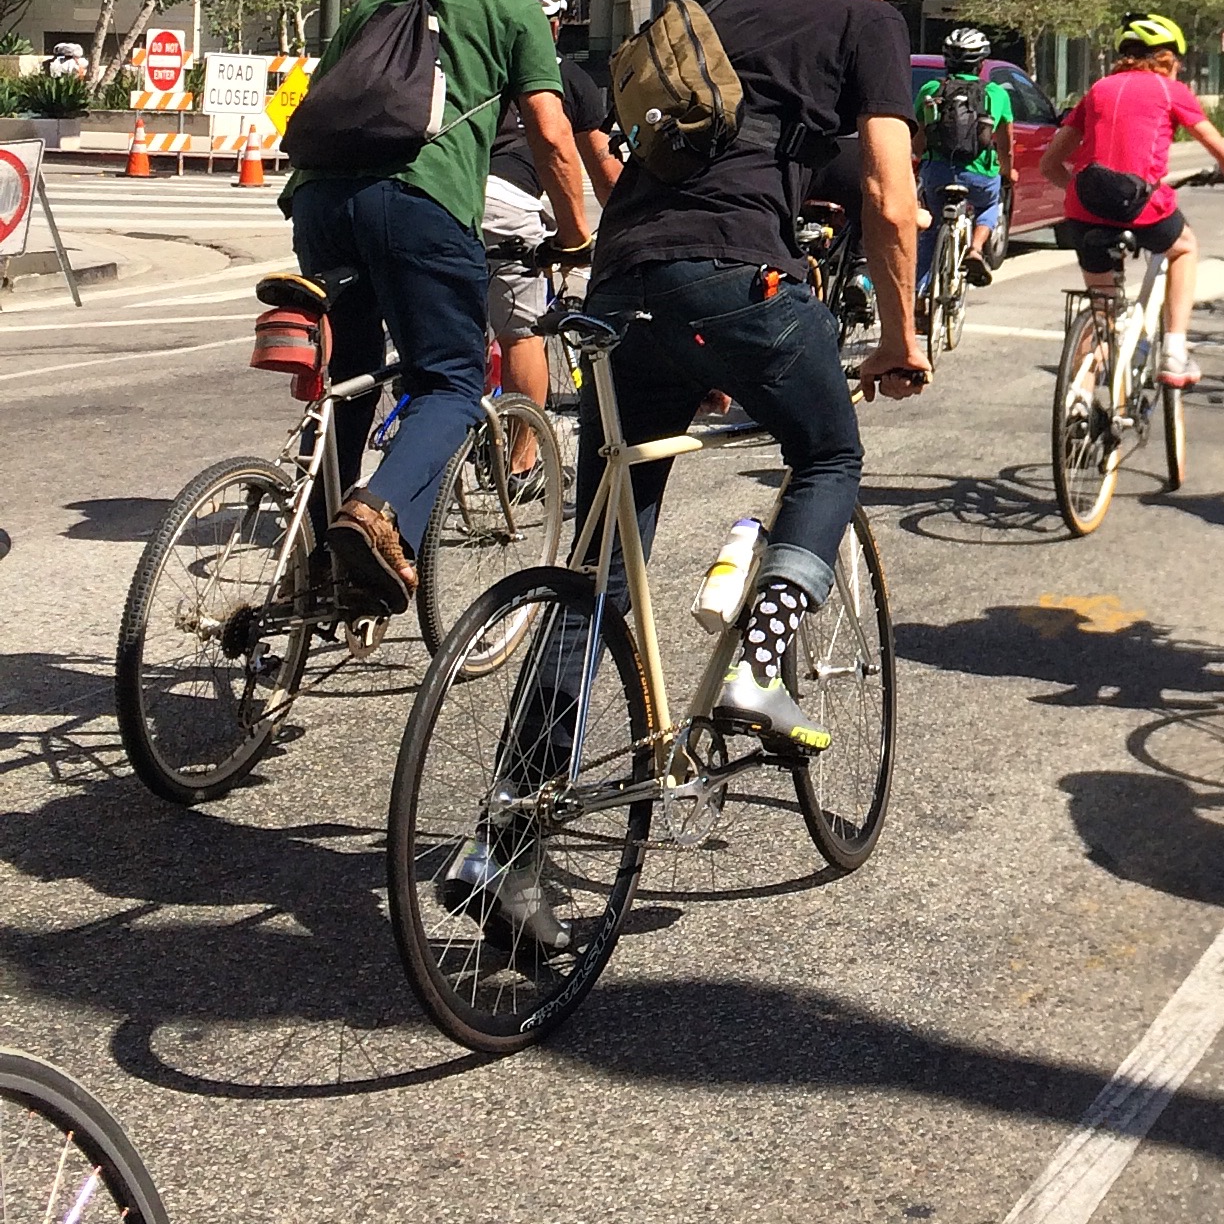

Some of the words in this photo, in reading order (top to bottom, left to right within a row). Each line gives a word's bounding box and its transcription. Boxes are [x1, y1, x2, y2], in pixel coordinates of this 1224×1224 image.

[151, 42, 163, 53] DO
[165, 42, 179, 53] NOT
[153, 69, 176, 81] ENTER
[218, 63, 254, 82] ROAD
[209, 88, 259, 107] CLOSED
